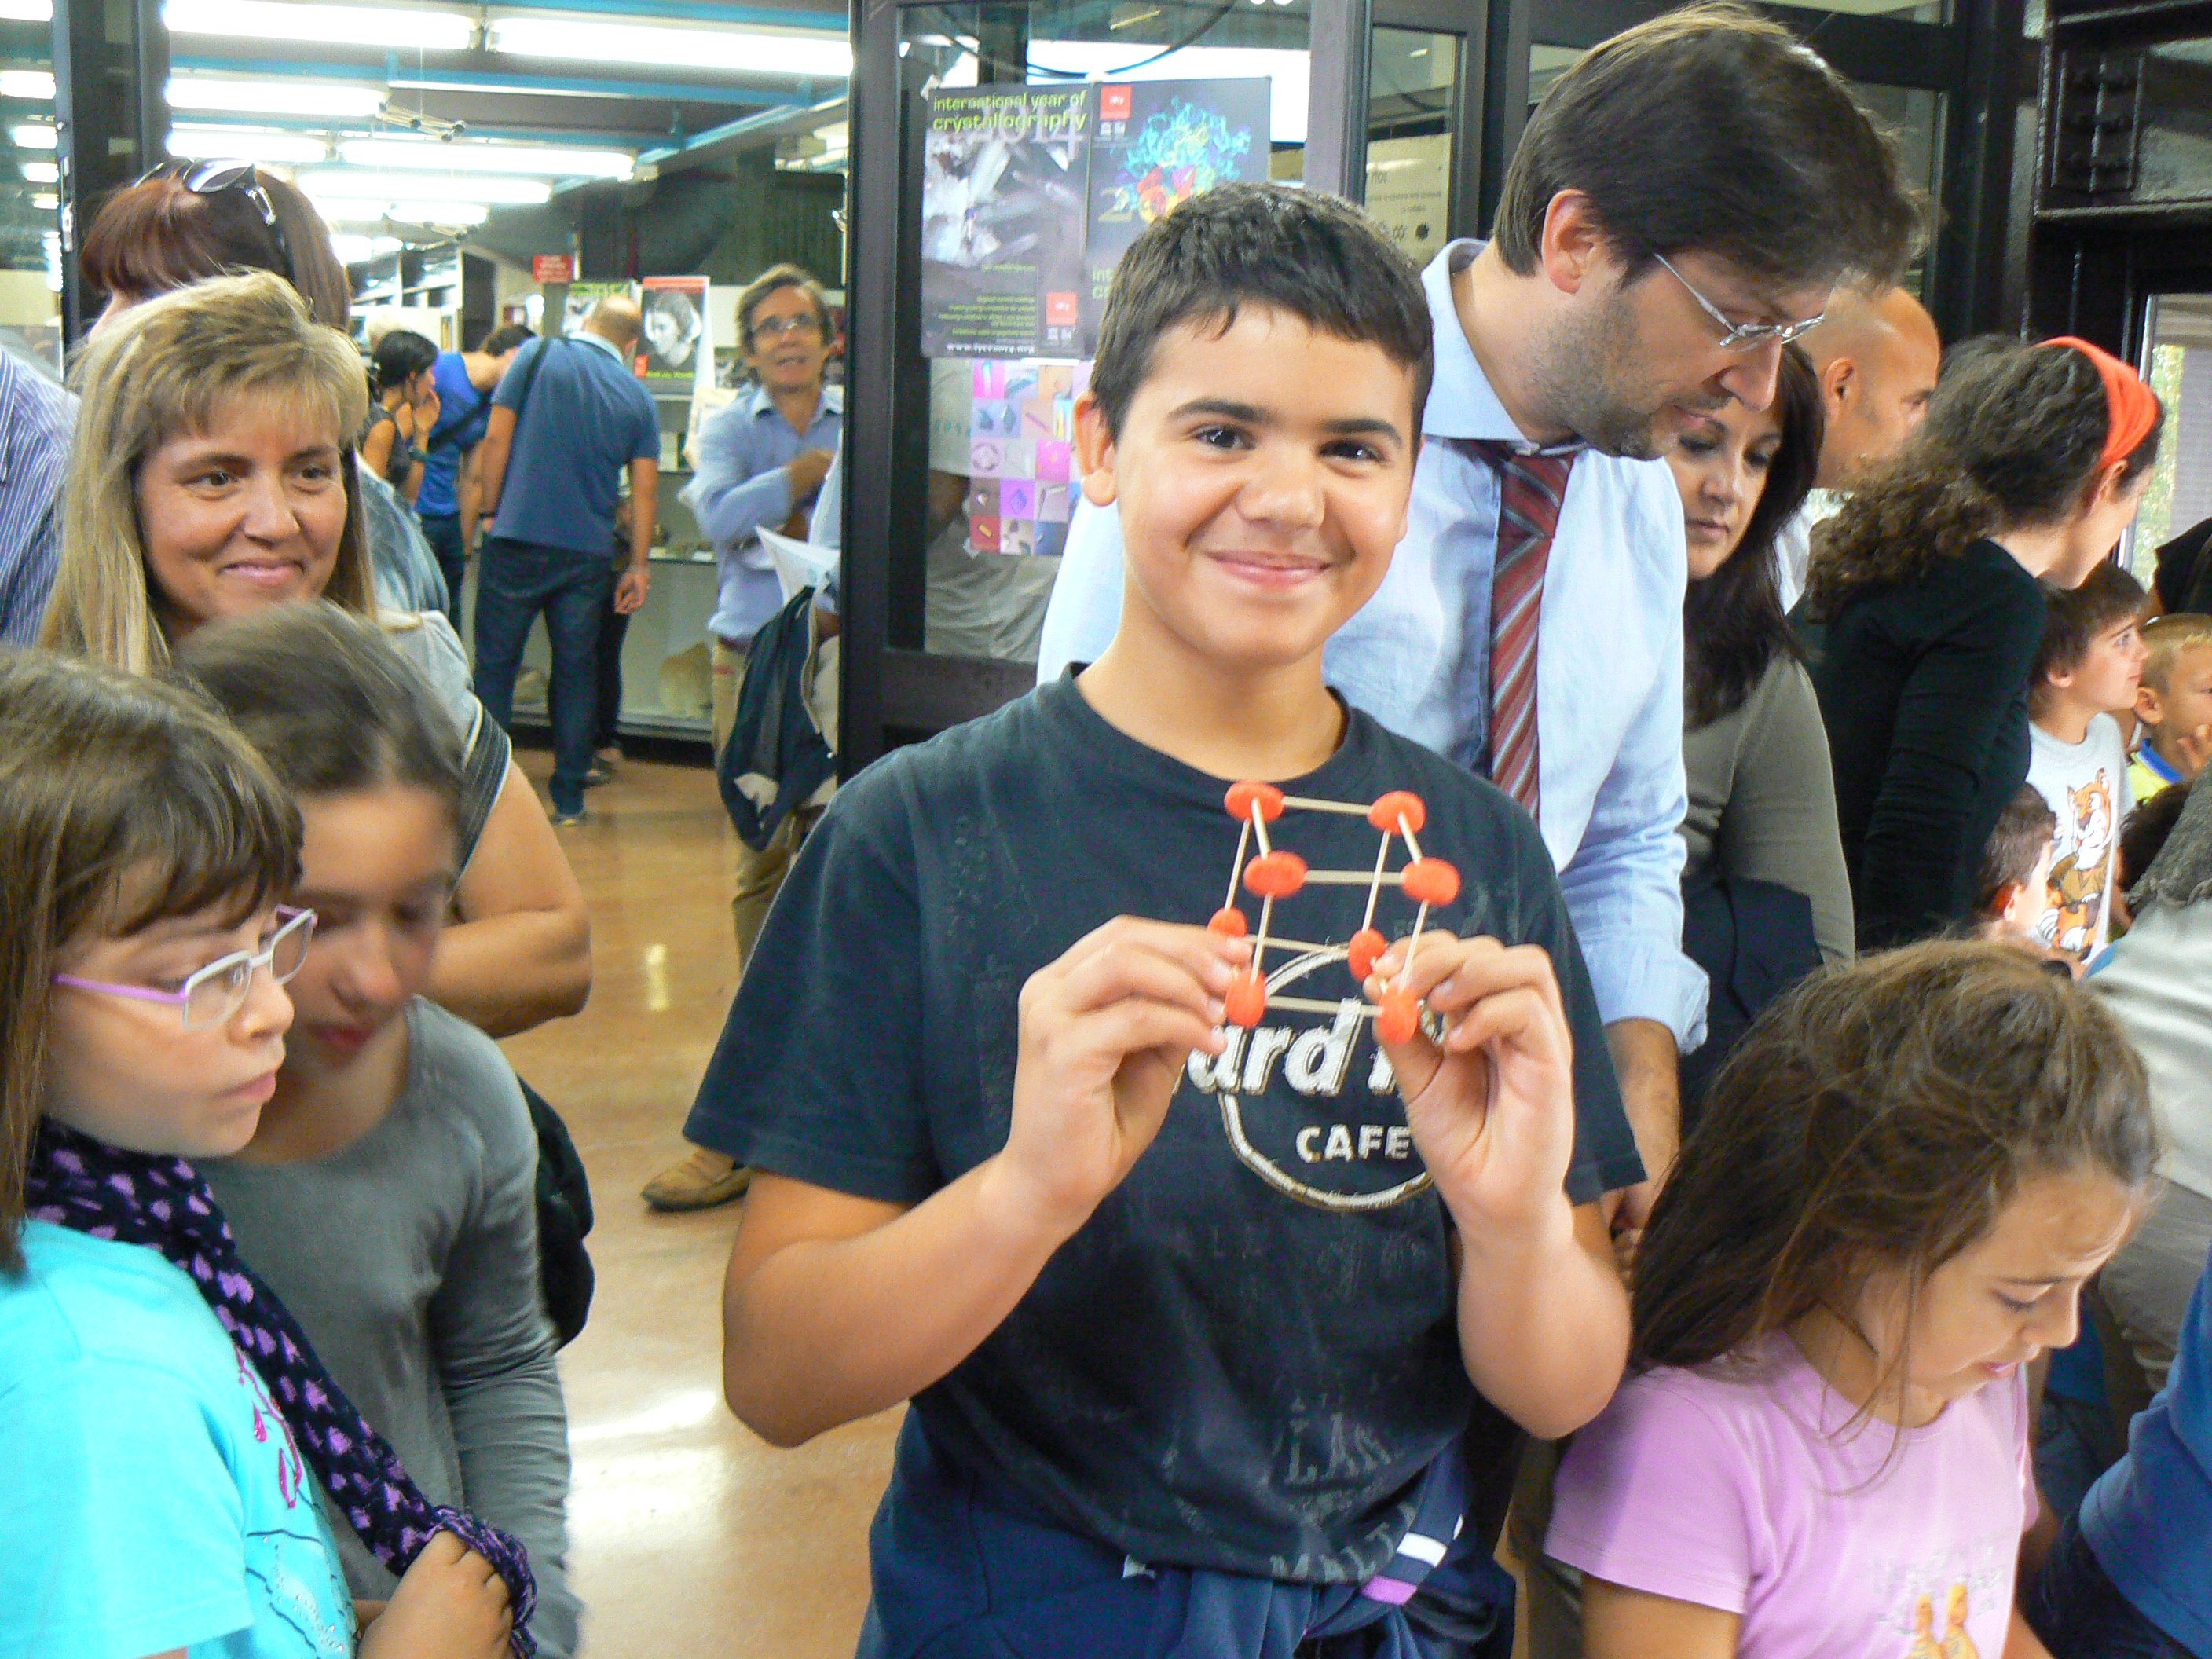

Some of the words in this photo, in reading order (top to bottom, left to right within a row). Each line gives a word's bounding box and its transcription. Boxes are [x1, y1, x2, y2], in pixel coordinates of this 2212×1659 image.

[932, 91, 1028, 112] international
[1031, 93, 1068, 111] year
[1070, 89, 1089, 108] of
[932, 111, 1088, 134] crystallography
[1186, 996, 1361, 1097] ard
[1295, 1123, 1412, 1163] CAFE
